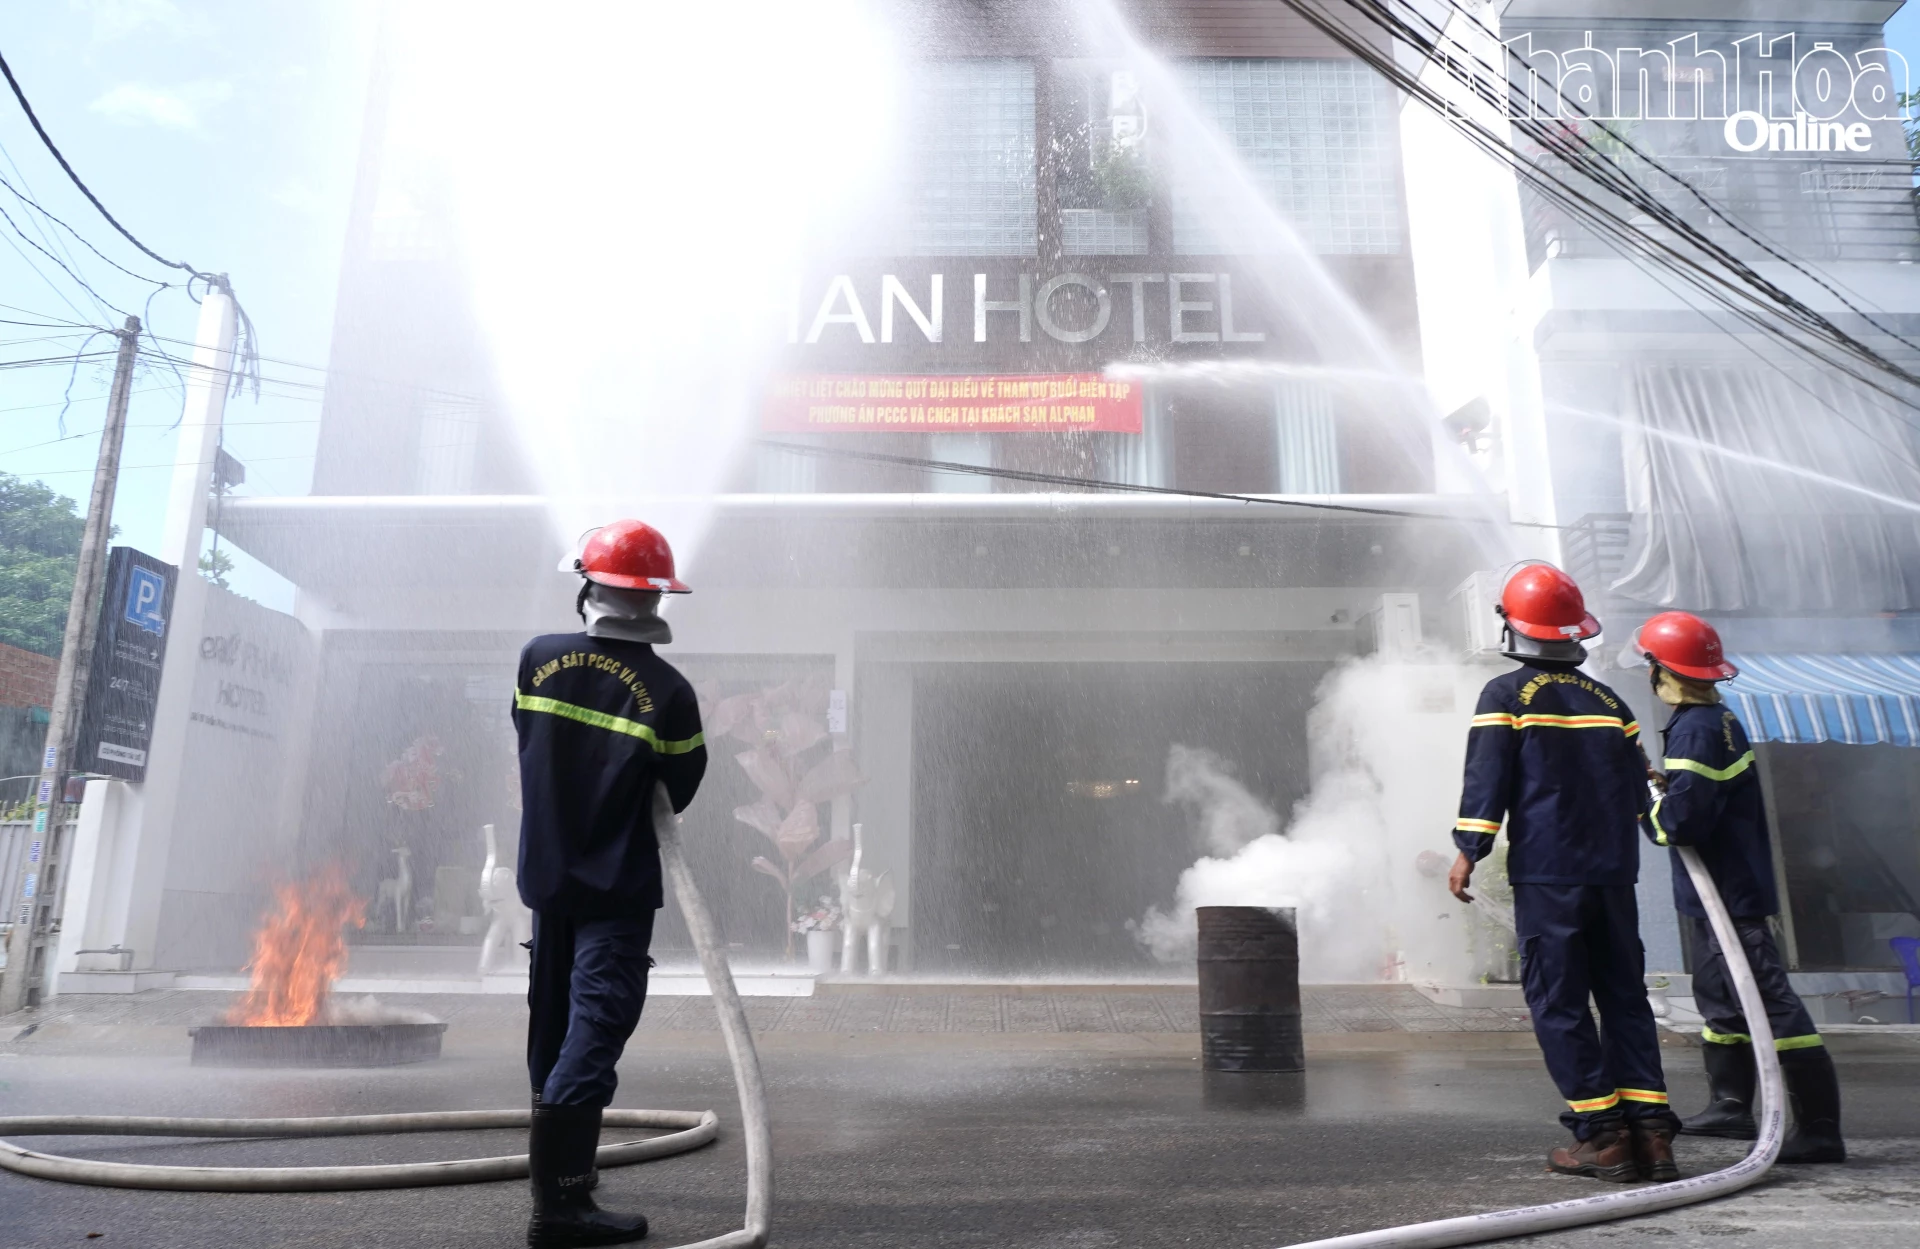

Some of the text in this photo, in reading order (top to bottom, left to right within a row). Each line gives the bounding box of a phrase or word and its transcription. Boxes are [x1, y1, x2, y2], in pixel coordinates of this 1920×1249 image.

[973, 272, 1266, 344] HOTEL
[905, 378, 927, 400] QUÝ
[929, 380, 950, 402] ĐẠI
[997, 381, 1030, 398] THAM
[1032, 380, 1050, 401] DỰ
[808, 403, 1096, 427] PHƯƠNG ÁN PCCC VÀ CNCH TẠI KHÁCH SẠN ALPHAN
[135, 579, 155, 614] P
[561, 650, 586, 669] SÁT
[587, 653, 622, 675] PCCC
[630, 680, 655, 714] CNCH
